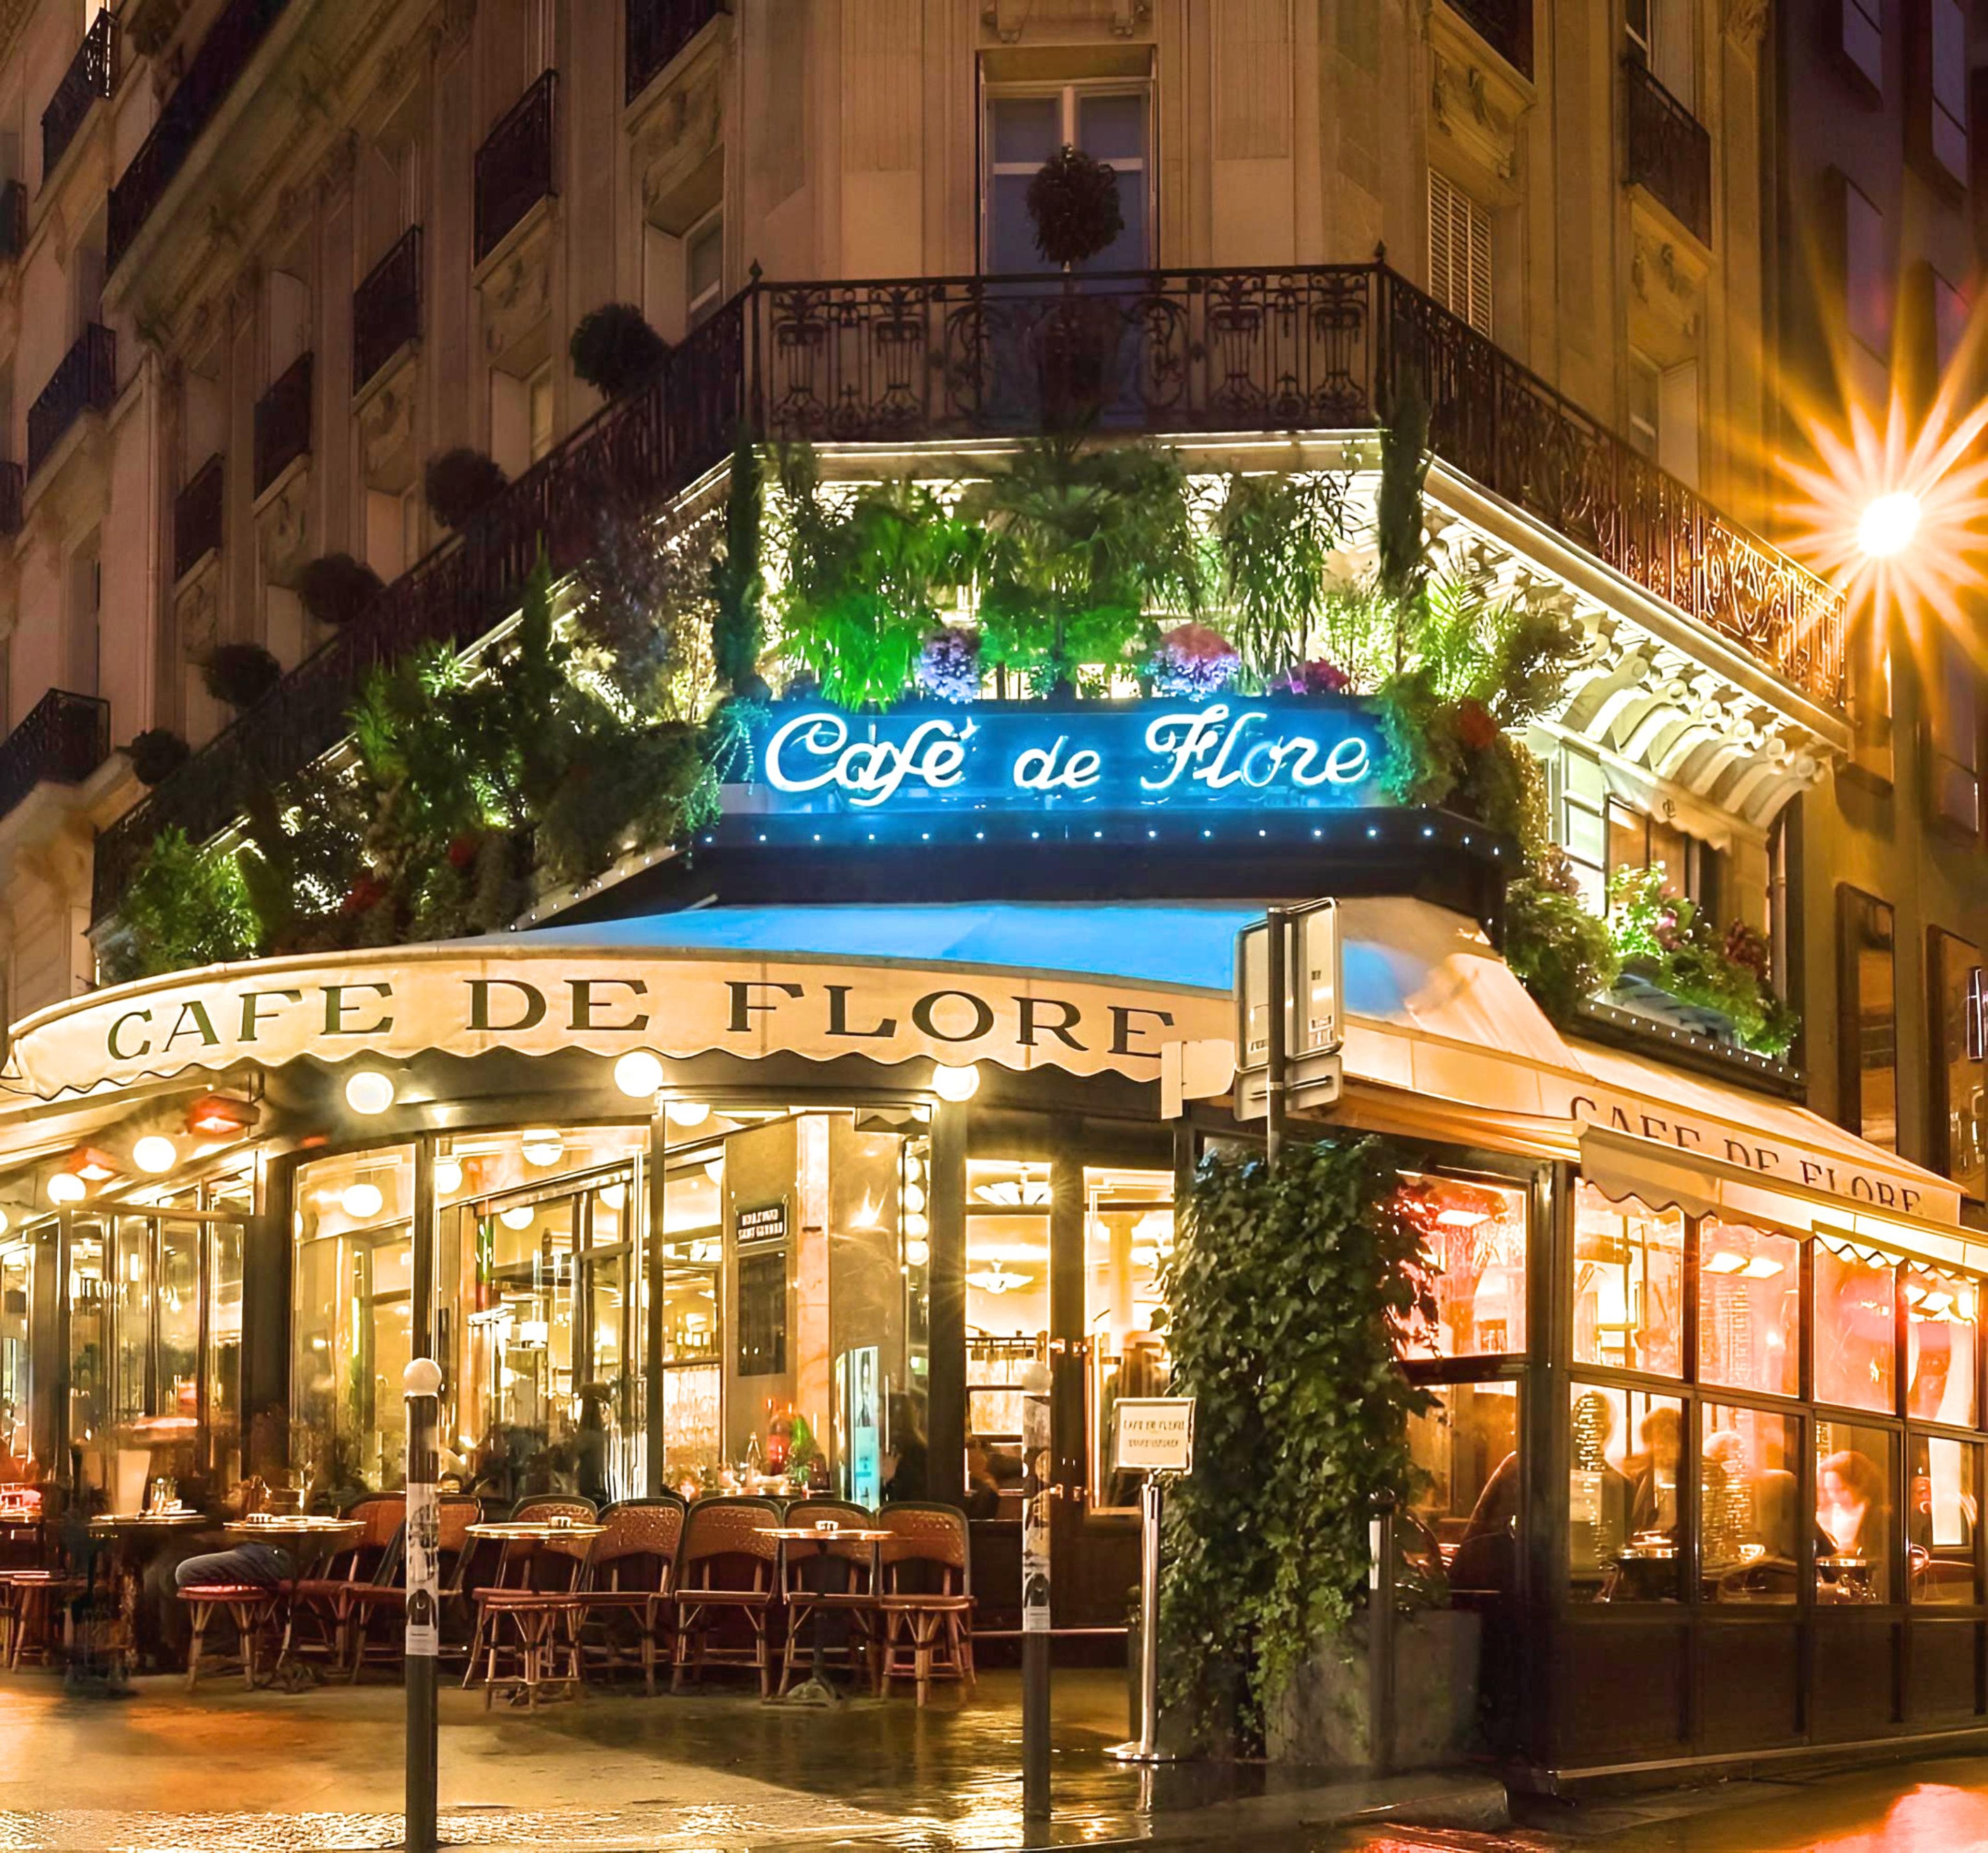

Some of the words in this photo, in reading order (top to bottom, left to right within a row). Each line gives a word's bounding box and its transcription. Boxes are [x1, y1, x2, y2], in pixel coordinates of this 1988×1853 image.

[765, 713, 981, 806] Café
[1013, 735, 1101, 789] de
[1141, 704, 1370, 789] Flore
[107, 982, 394, 1061] CAFE
[464, 979, 649, 1031] DE
[725, 981, 1175, 1058] FLORE
